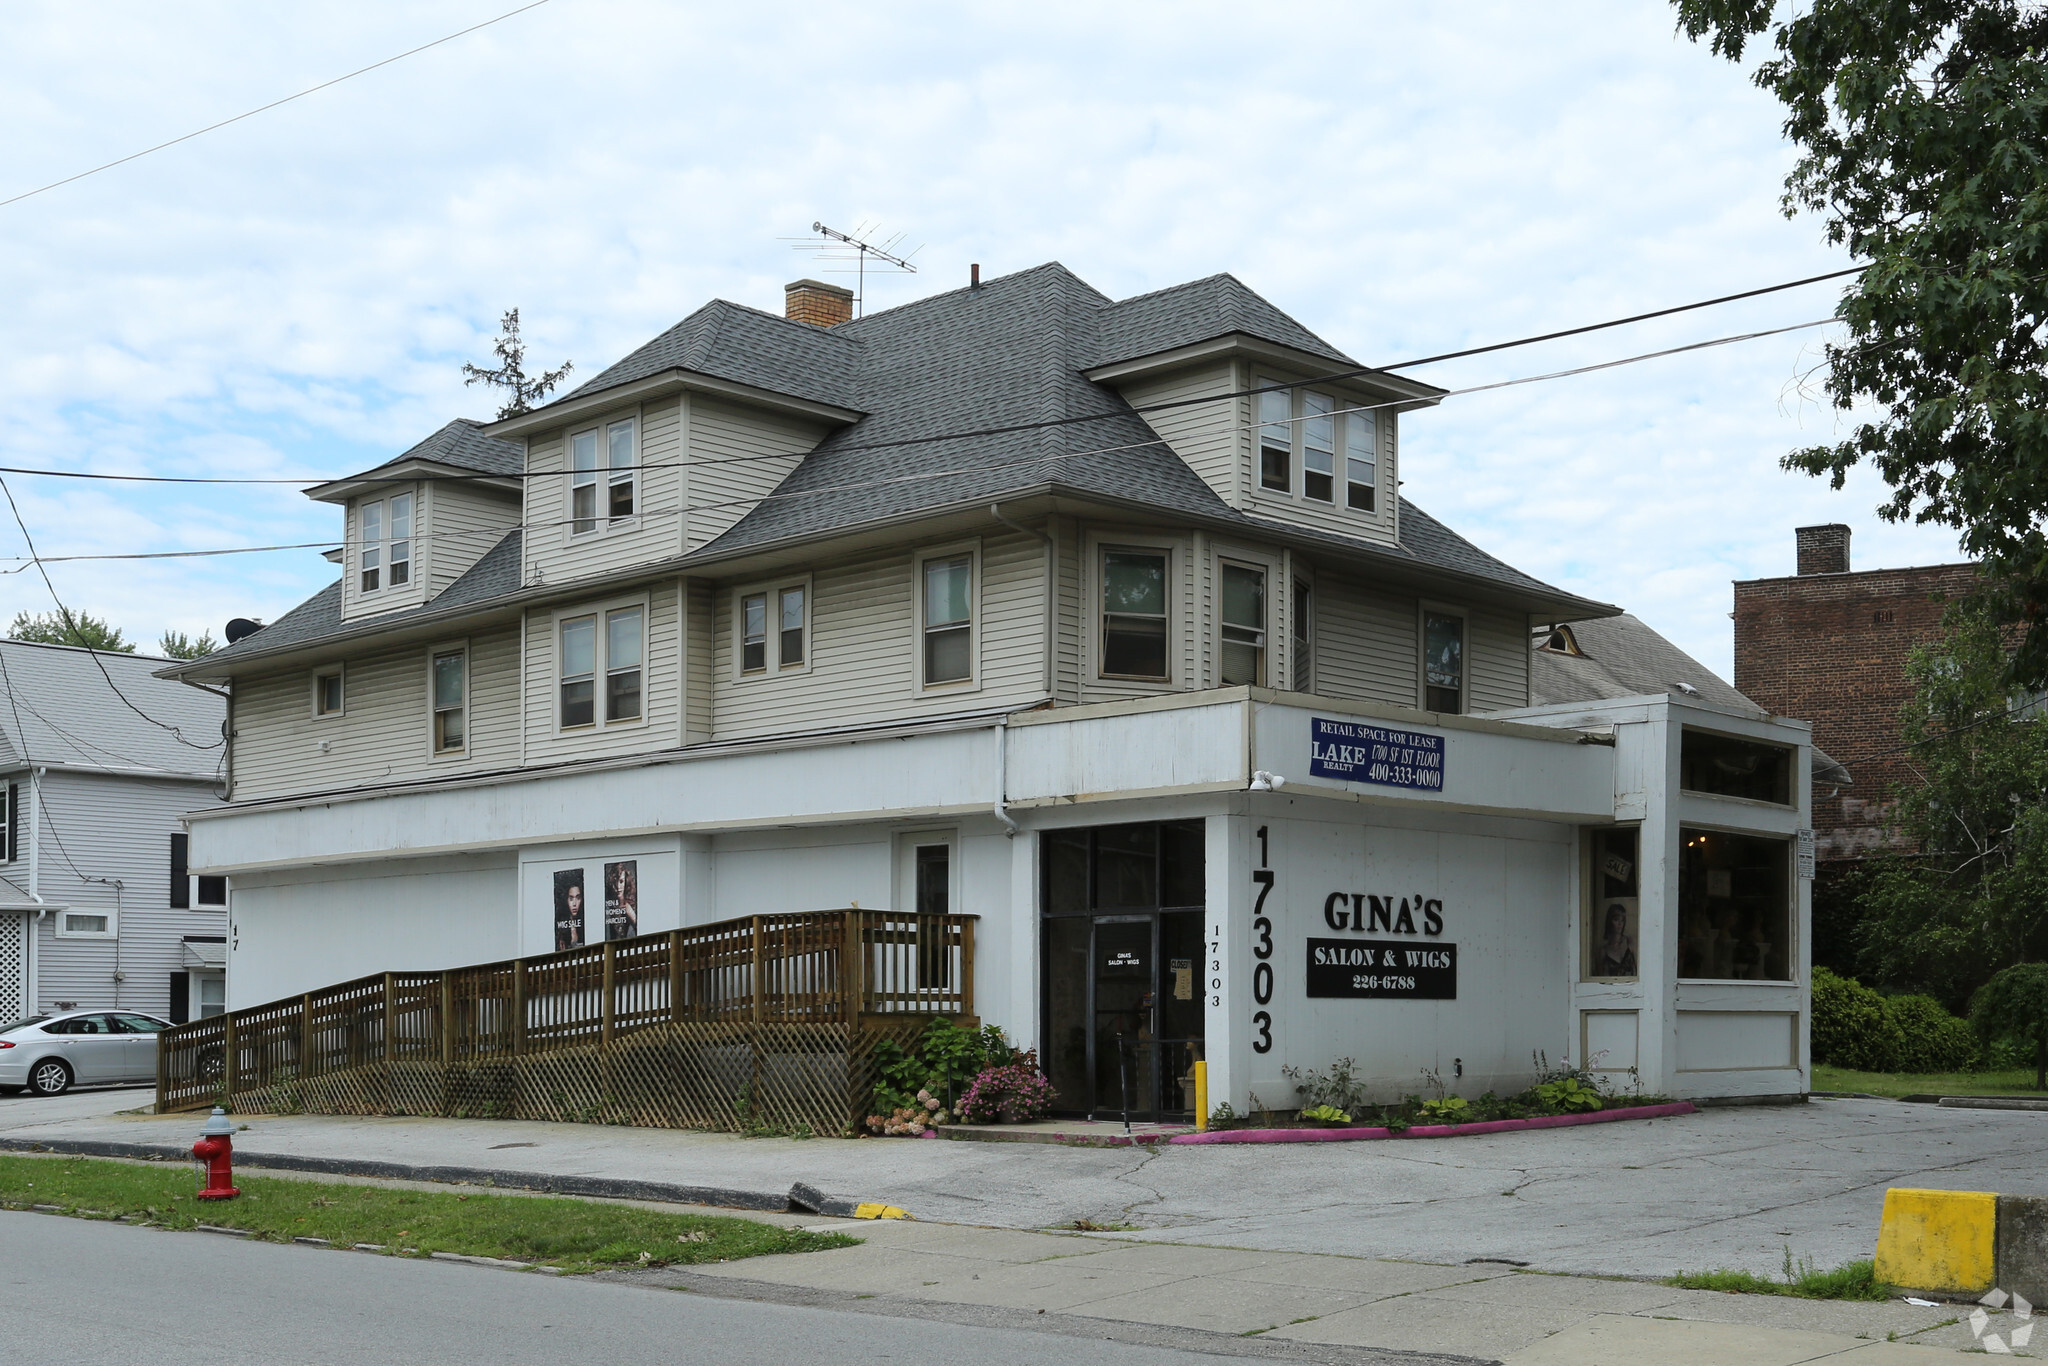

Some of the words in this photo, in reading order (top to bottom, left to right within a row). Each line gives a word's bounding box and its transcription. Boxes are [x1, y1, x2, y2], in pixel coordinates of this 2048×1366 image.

[1320, 721, 1355, 737] RETAIL
[1357, 727, 1387, 742] SPACE
[1389, 732, 1406, 745] FOR
[1409, 735, 1437, 749] LEASE
[1312, 741, 1366, 766] LAKE
[1371, 744, 1388, 761] 1700
[1390, 746, 1400, 763] SF
[1400, 749, 1415, 765] 1ST
[1415, 750, 1440, 768] FLOOR
[1323, 761, 1354, 772] REALTY
[1369, 763, 1440, 788] 400-333-0000
[1606, 858, 1627, 875] SALE
[605, 899, 615, 907] MEN
[1324, 891, 1443, 936] GINA'S
[568, 919, 581, 928] SALE
[605, 916, 627, 924] HAIRCUTS
[1252, 825, 1275, 1054] 17303
[1211, 925, 1221, 1007] 17303
[1314, 946, 1375, 967] SALON
[1383, 949, 1397, 967] &
[1405, 950, 1451, 969] WIGS
[1352, 974, 1415, 990] 226-6788
